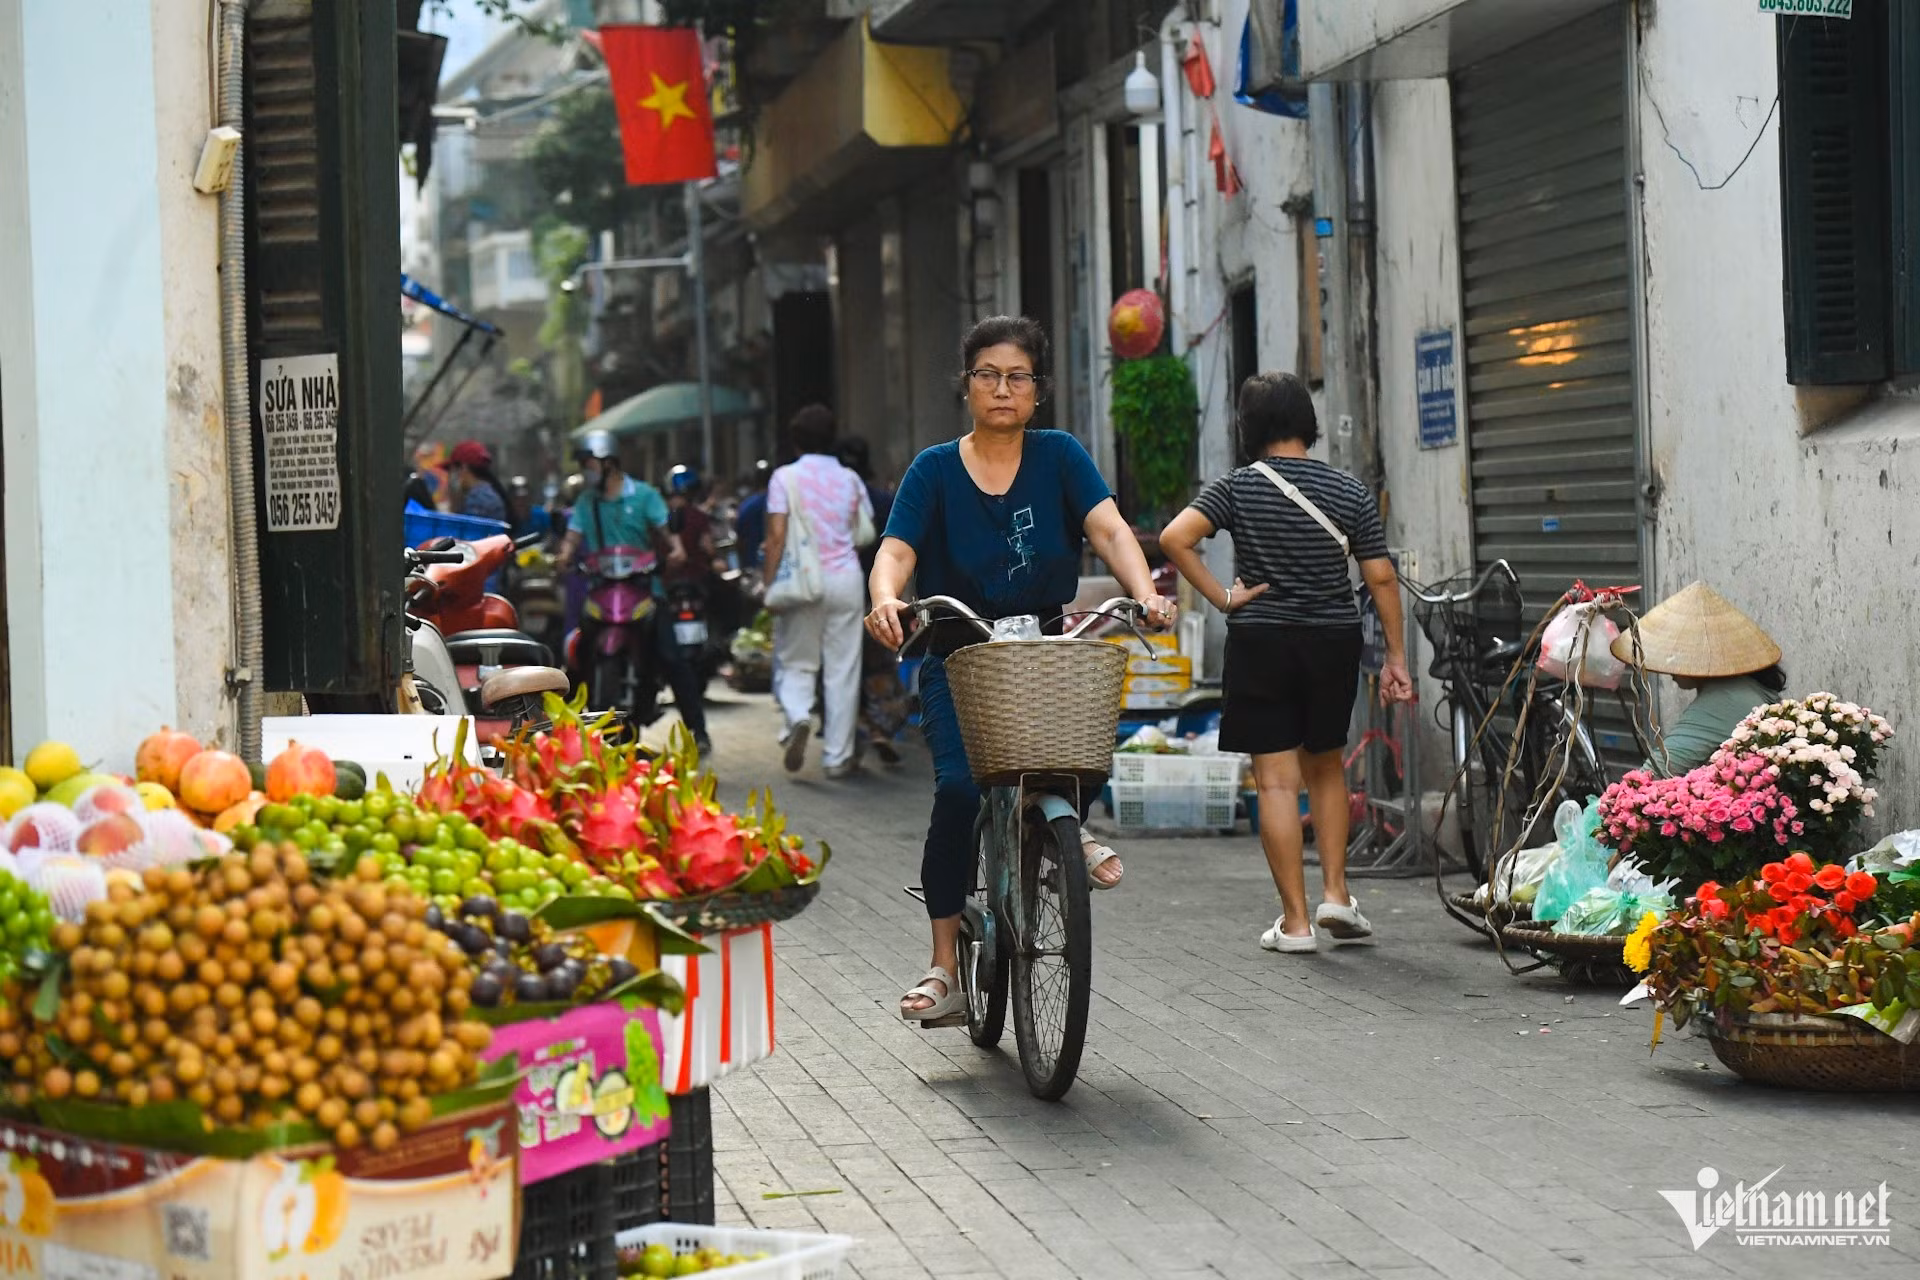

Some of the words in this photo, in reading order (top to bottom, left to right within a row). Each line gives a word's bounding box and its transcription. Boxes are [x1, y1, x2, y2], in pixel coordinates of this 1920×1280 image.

[265, 365, 297, 413] SỬA
[302, 367, 337, 410] NHÀ
[270, 493, 289, 527] 056
[292, 492, 311, 525] 255
